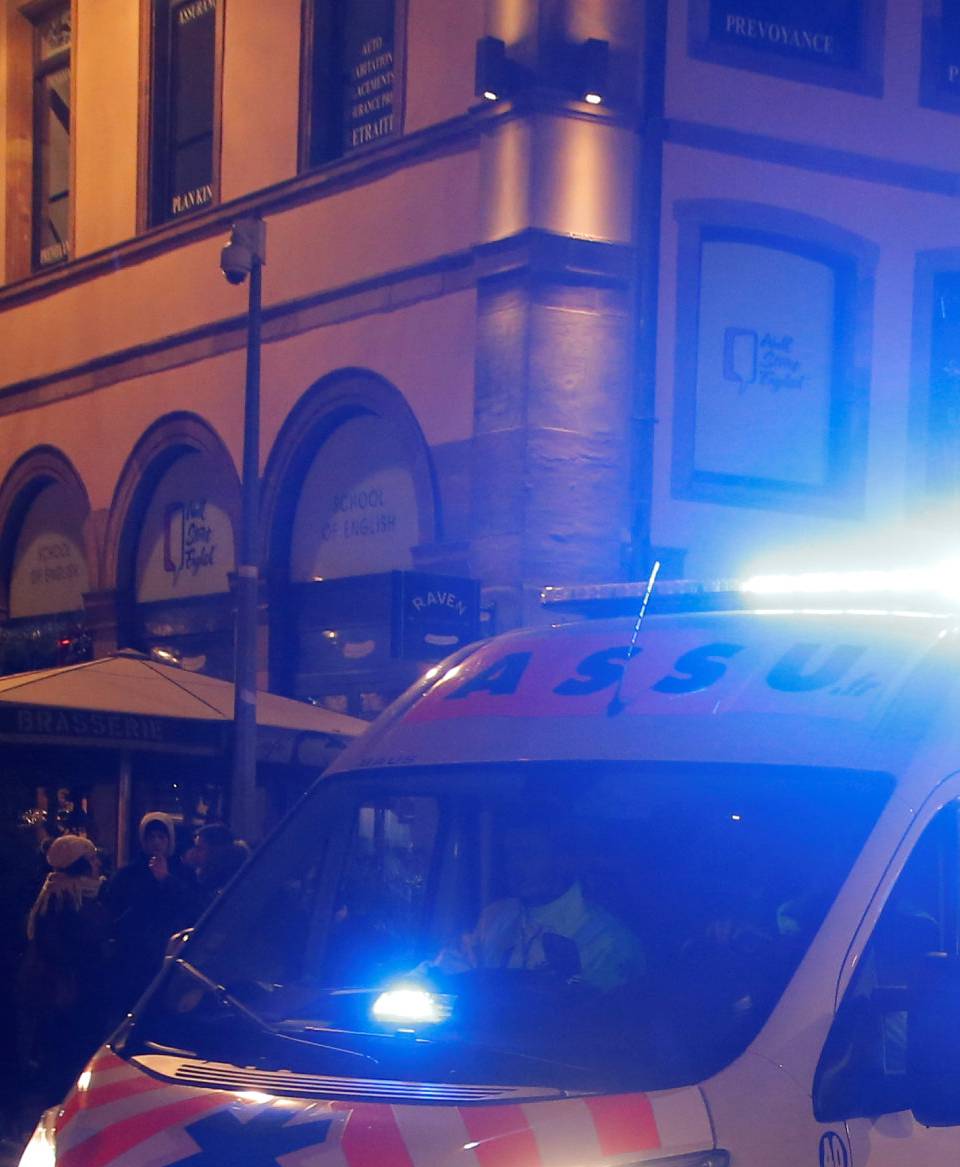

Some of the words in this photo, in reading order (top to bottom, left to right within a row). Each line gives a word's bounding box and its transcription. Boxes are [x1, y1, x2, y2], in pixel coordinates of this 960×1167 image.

[725, 14, 834, 54] PREVOYANCE
[410, 590, 468, 617] RAVEN
[17, 709, 164, 741] BRASSERIE
